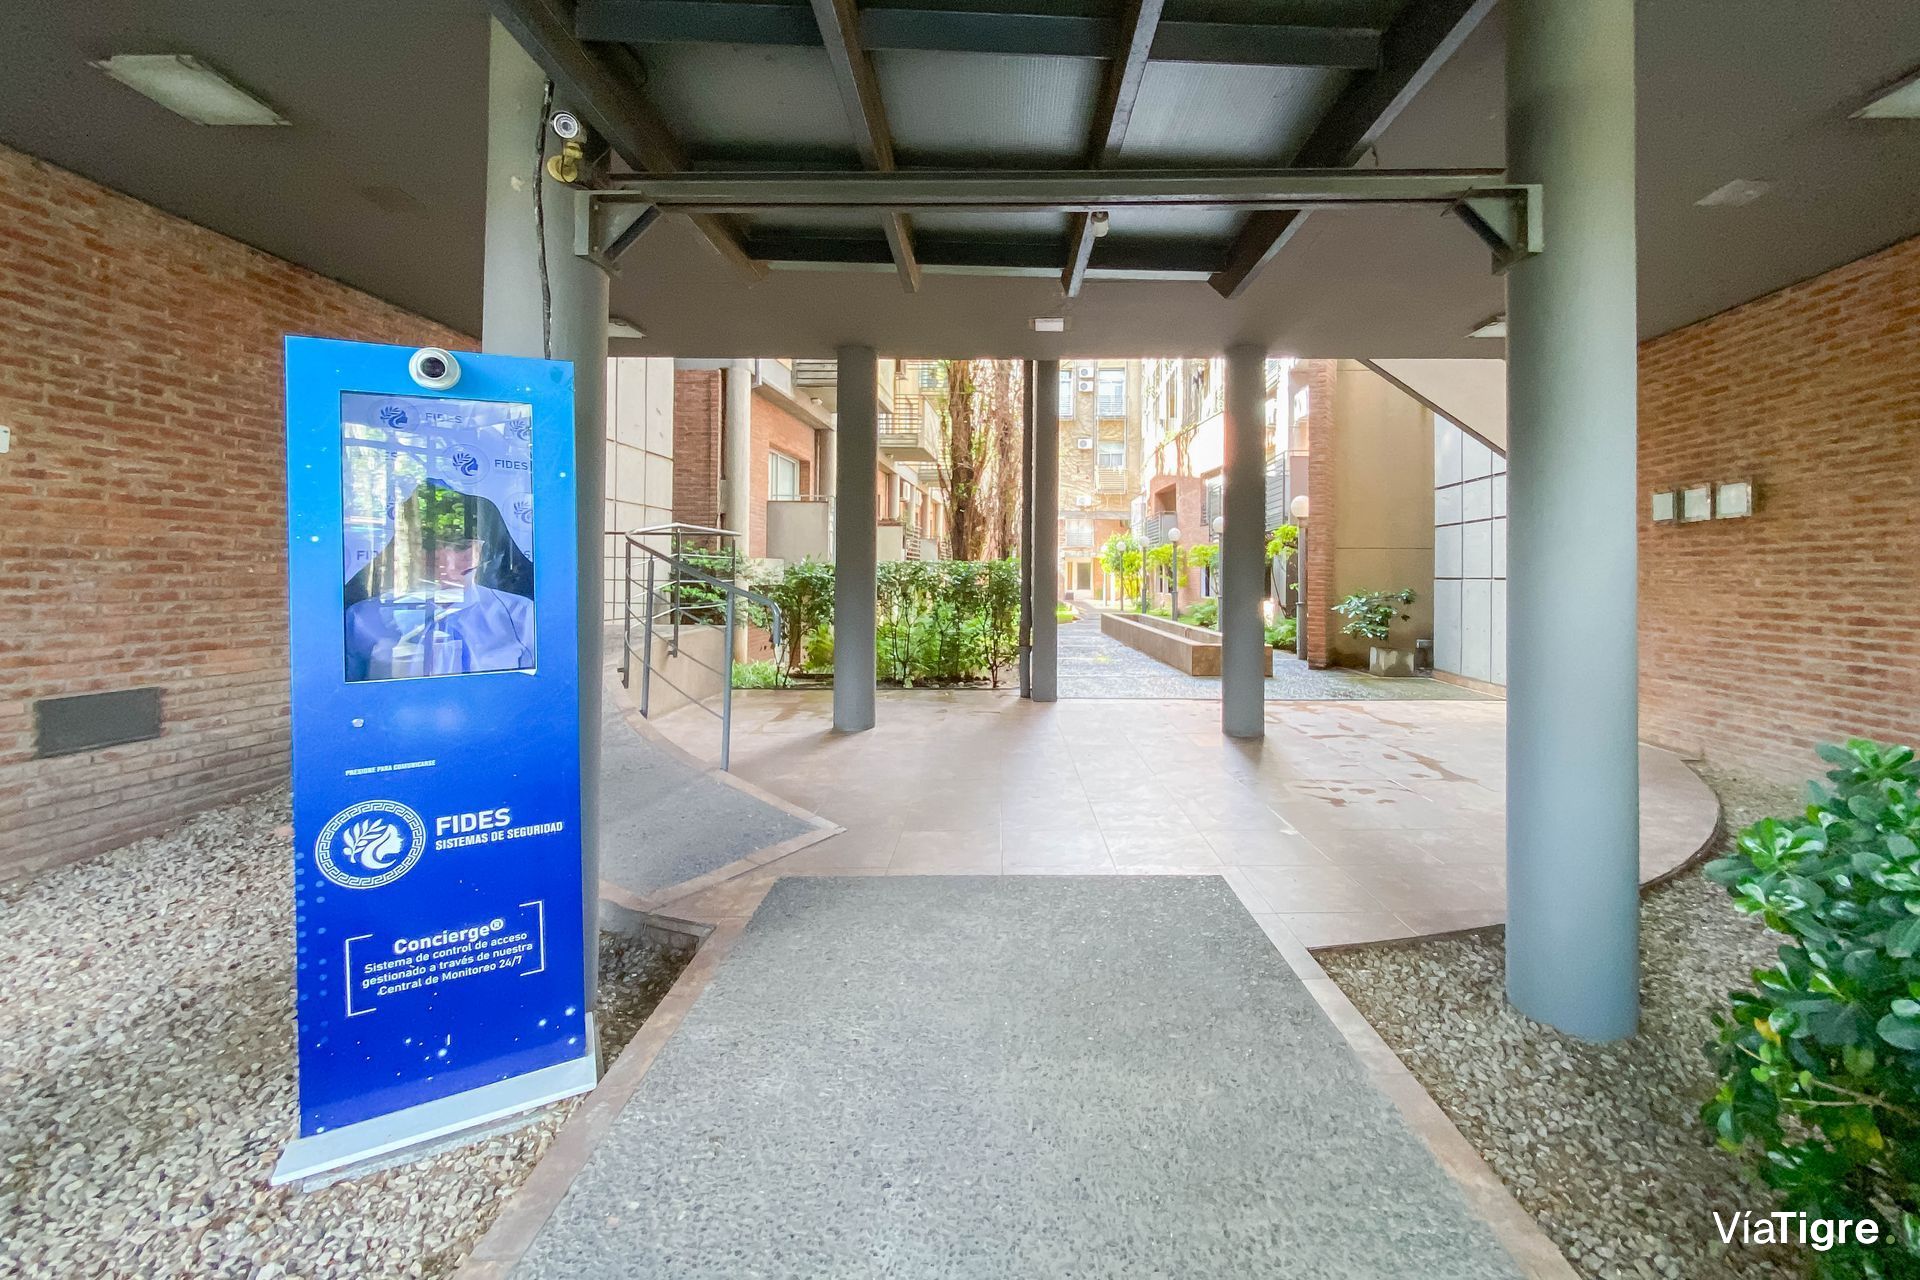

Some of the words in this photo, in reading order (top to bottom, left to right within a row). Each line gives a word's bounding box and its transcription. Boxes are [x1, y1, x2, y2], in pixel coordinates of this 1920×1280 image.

[494, 459, 529, 471] FIDES
[377, 764, 393, 773] PARA
[435, 807, 511, 836] FIDES
[435, 832, 489, 851] SISTEMAS
[490, 829, 505, 842] DE
[506, 821, 564, 840] SEGURIDAD
[362, 966, 427, 989] gestionado
[429, 964, 437, 972] a
[439, 954, 474, 970] través
[476, 952, 490, 963] de
[492, 942, 533, 959] nuestra
[364, 957, 413, 974] Sistema
[415, 952, 430, 963] de
[432, 943, 472, 960] control
[474, 940, 488, 951] de
[490, 932, 528, 947] acceso
[378, 978, 423, 996] Central
[425, 975, 439, 986] de
[442, 962, 497, 982] Monitoreo
[498, 955, 523, 970] 24/7
